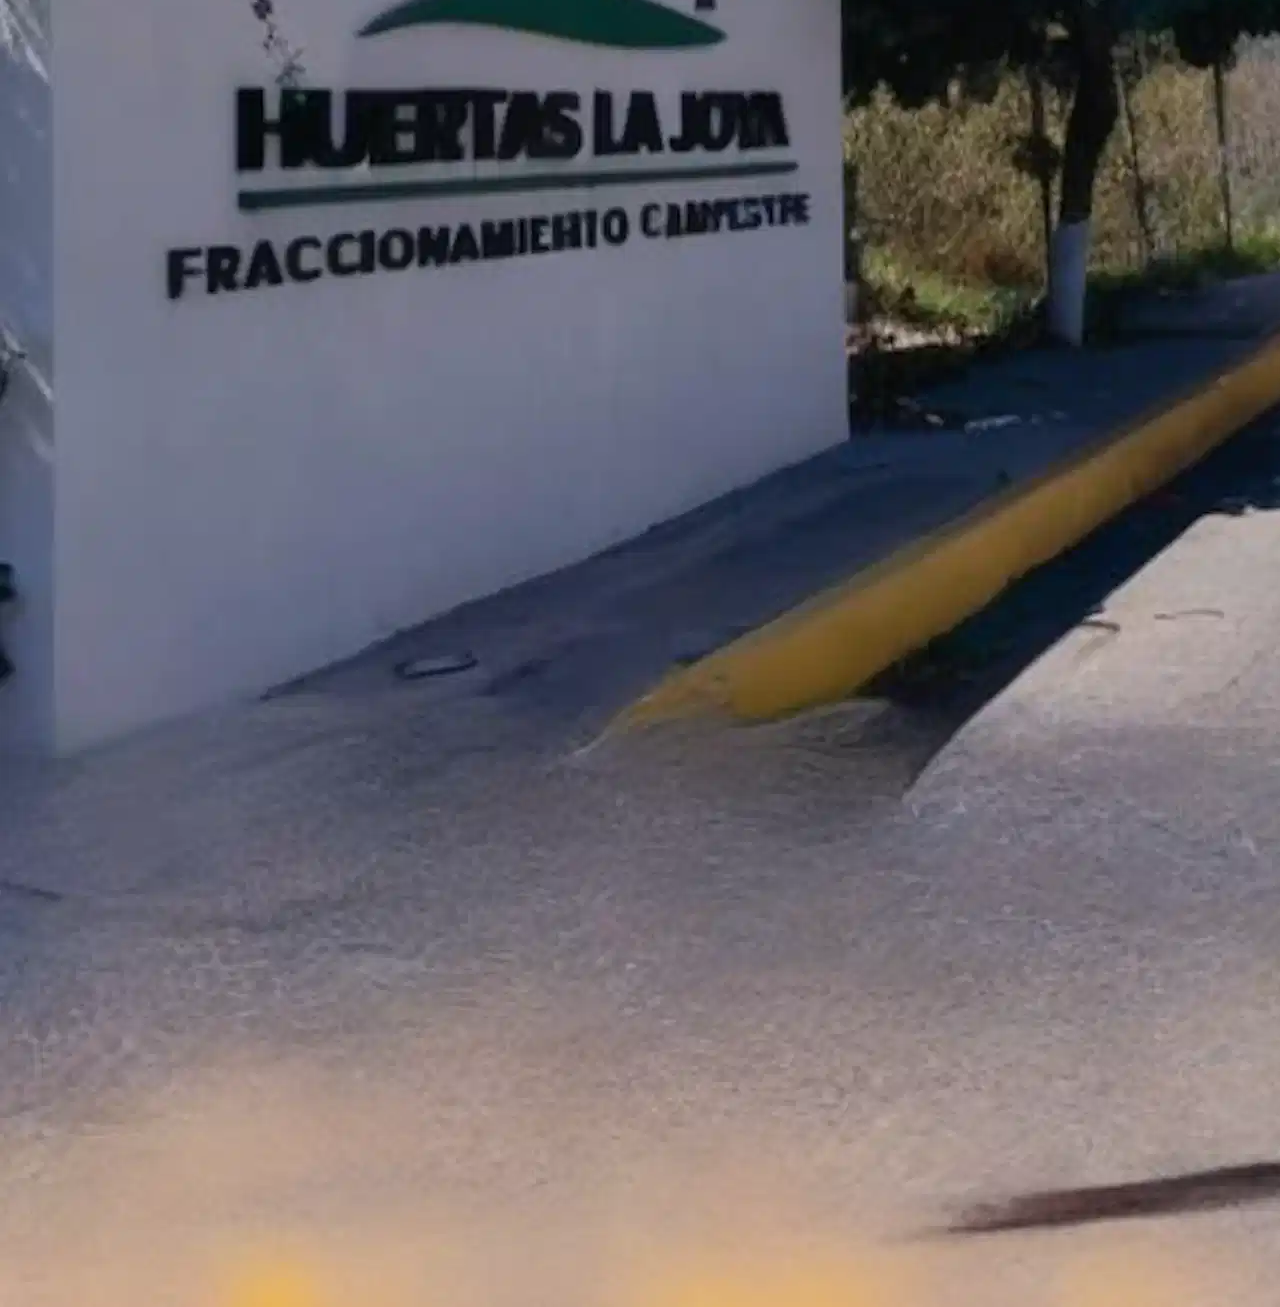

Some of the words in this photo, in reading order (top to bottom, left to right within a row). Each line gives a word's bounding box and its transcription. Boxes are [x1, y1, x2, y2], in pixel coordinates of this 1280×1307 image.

[235, 86, 584, 172] HUERTAS
[593, 87, 664, 155] LA
[669, 90, 790, 152] JOYA
